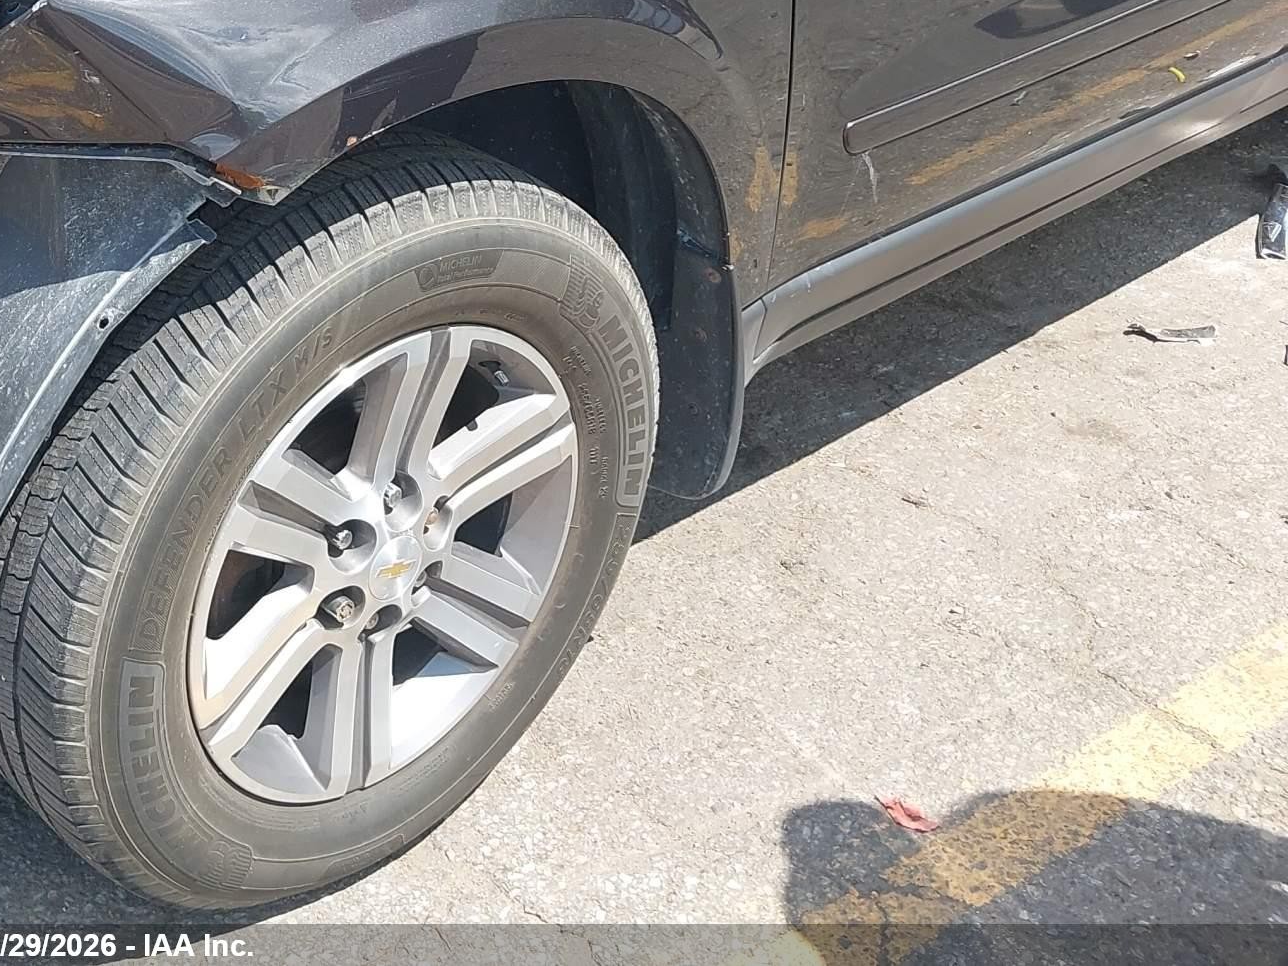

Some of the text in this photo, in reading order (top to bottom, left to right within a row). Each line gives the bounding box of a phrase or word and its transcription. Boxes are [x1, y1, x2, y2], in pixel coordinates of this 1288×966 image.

[141, 325, 333, 641] DEFENDER LTX M/S
[598, 313, 647, 496] MICHELIN
[126, 675, 206, 842] MICHELIN
